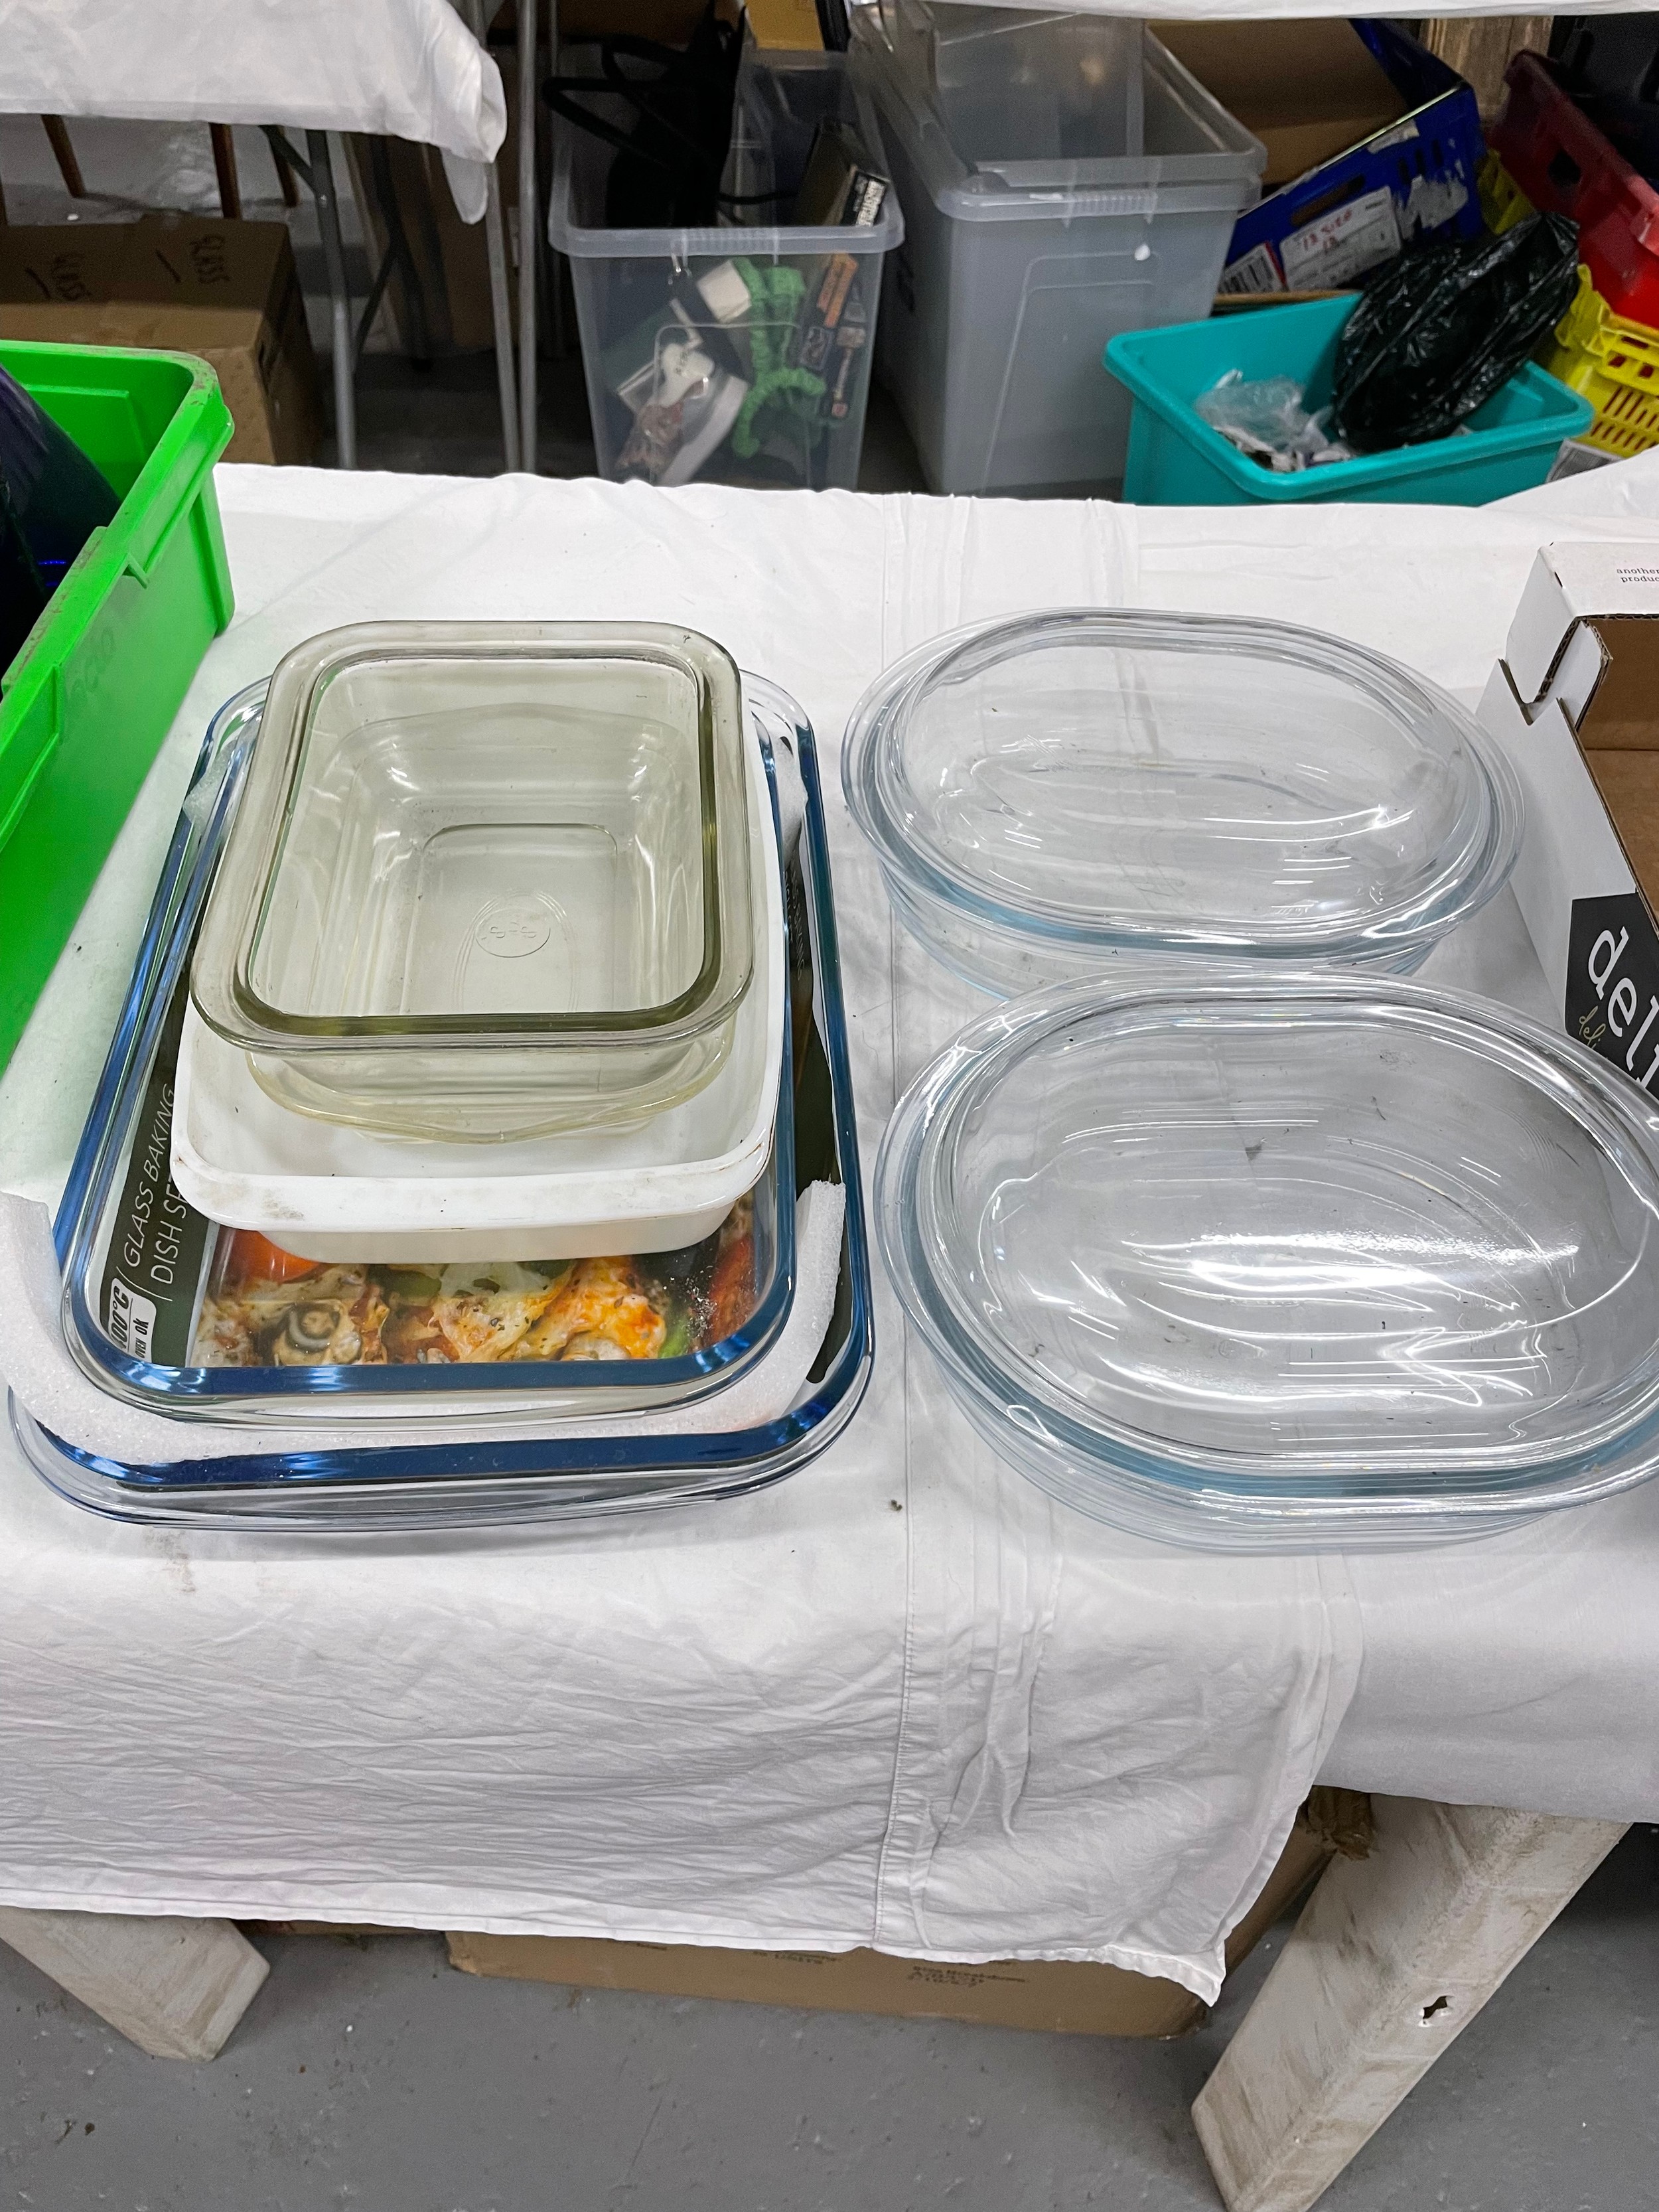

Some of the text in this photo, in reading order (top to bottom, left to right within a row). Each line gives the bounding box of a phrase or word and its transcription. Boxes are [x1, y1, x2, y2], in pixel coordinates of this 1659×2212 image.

[124, 1083, 175, 1267] GLASS BAKING
[150, 1171, 188, 1284] DISH SE
